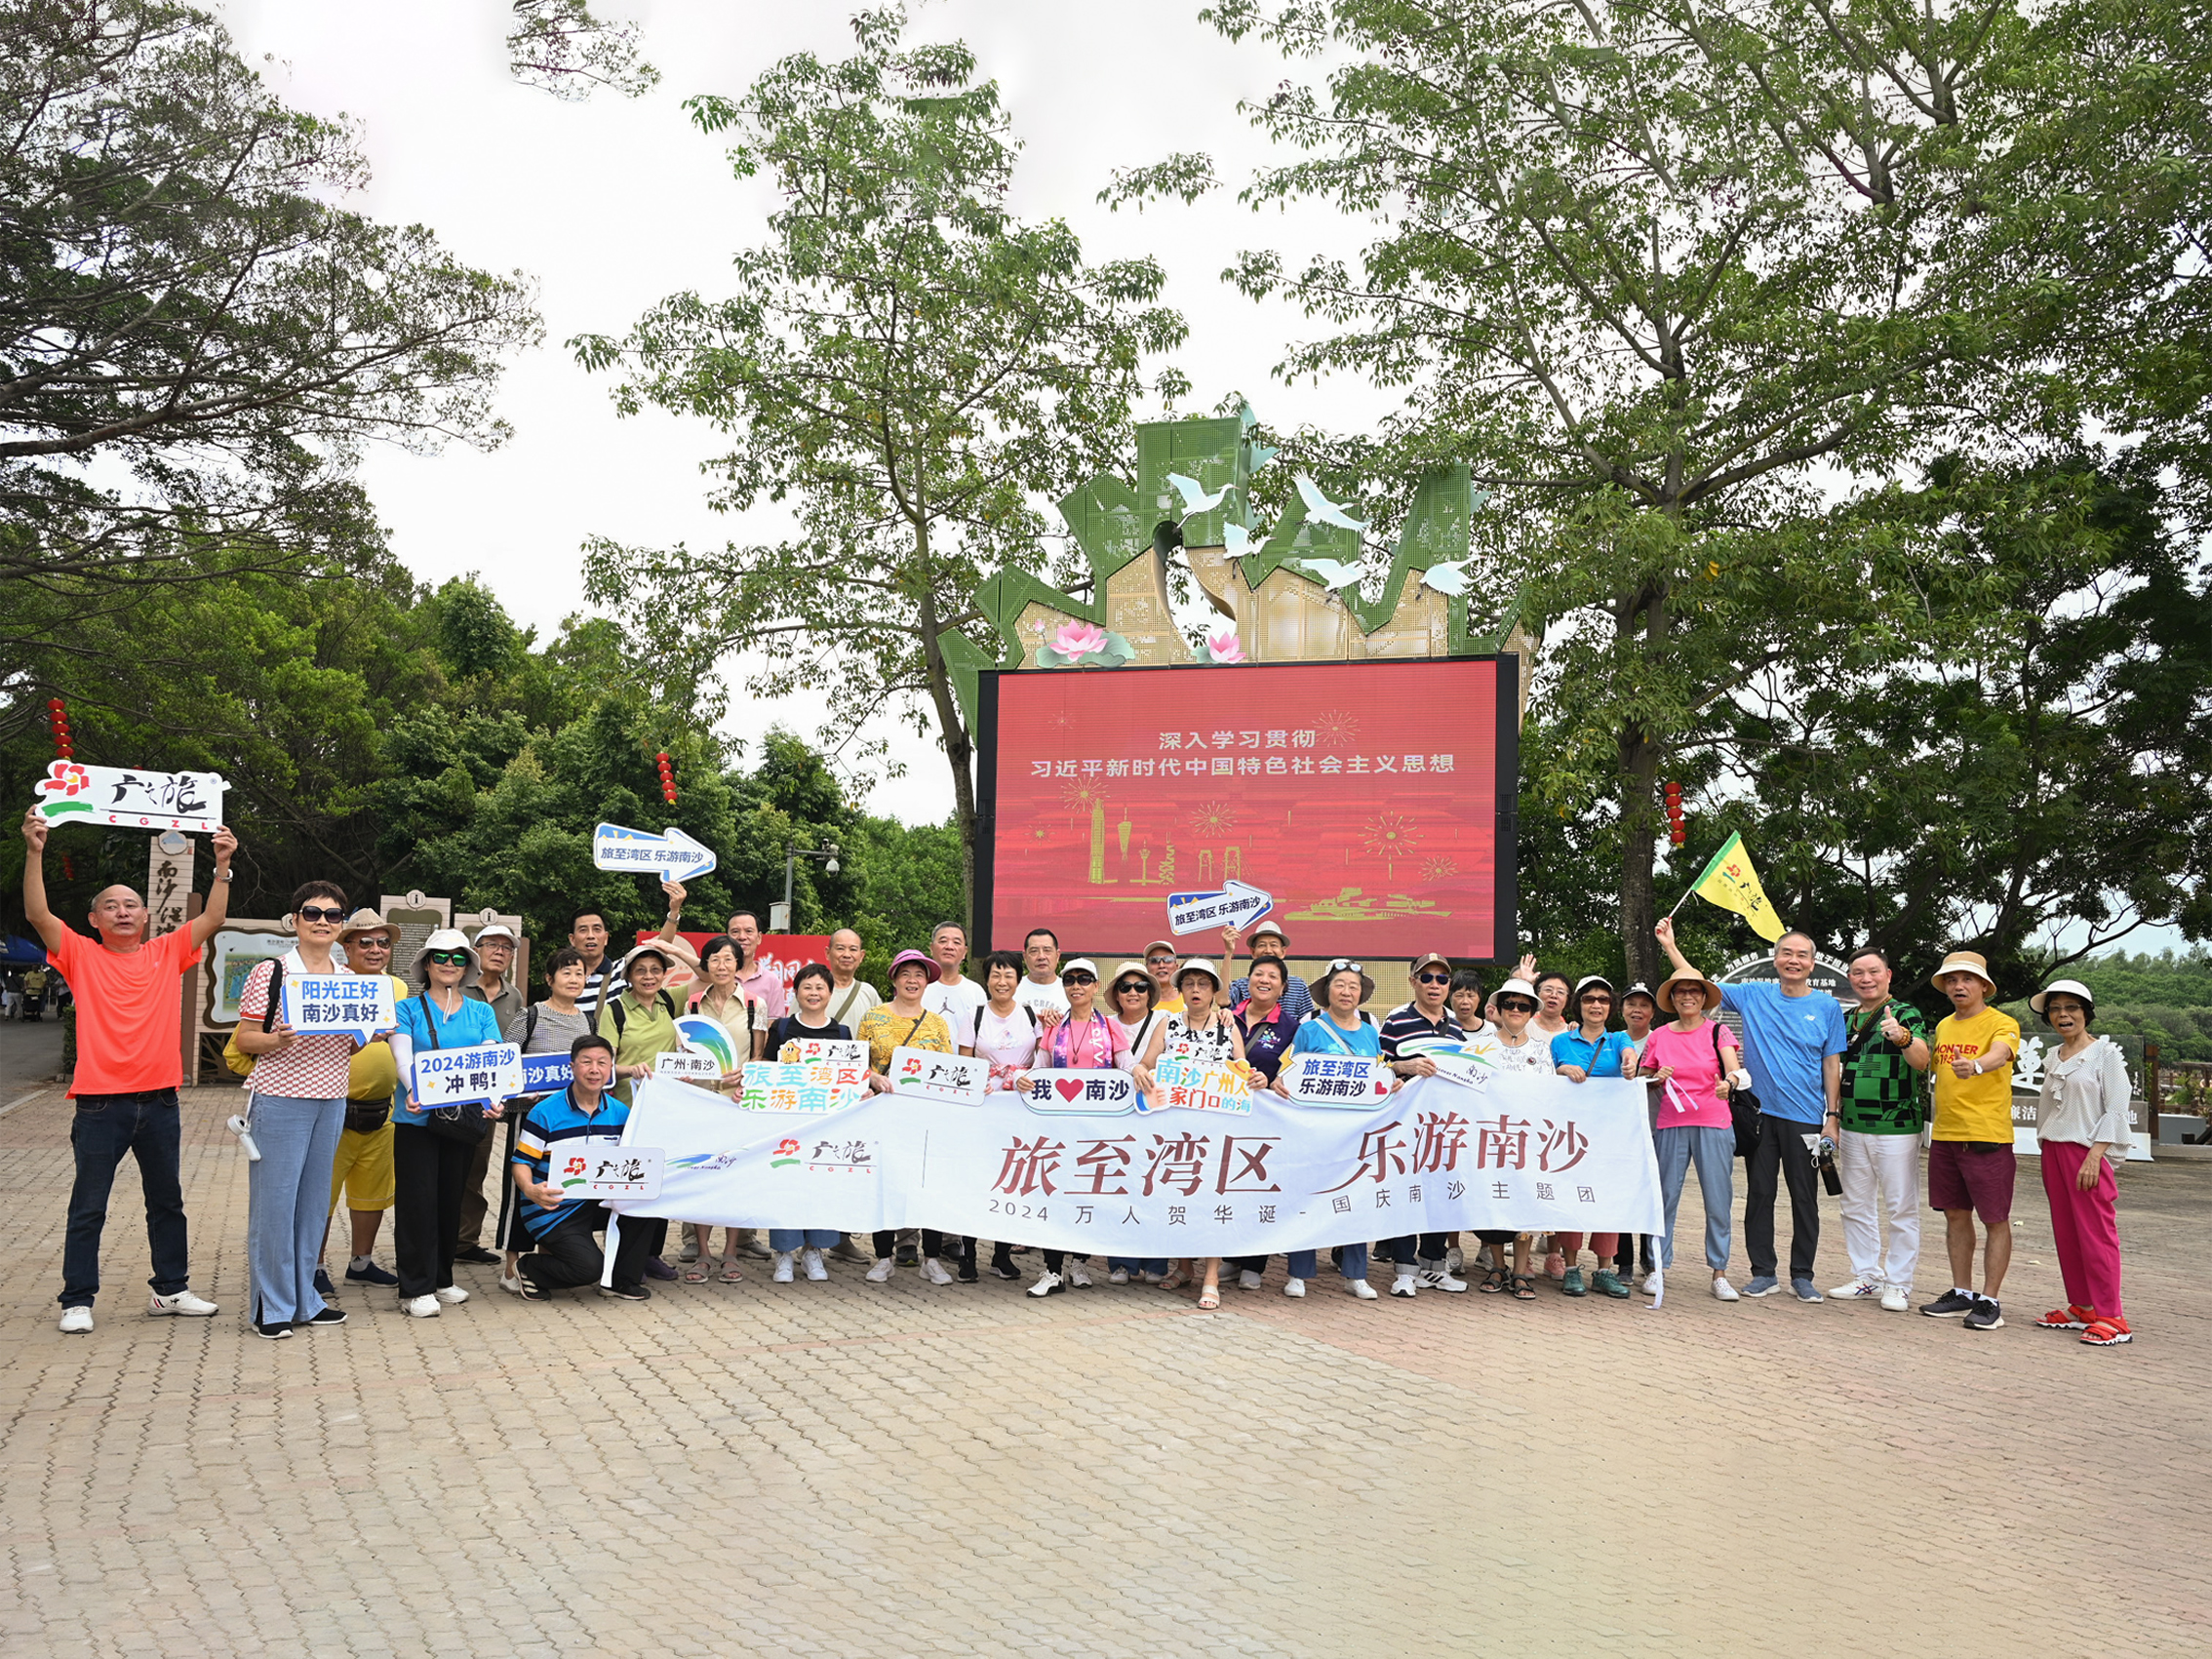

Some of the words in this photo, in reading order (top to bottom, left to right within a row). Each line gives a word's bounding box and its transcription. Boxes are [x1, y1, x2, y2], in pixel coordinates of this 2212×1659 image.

[1158, 729, 1317, 750] 深入学习贯彻
[1030, 753, 1455, 778] 习近平新时代中国特色社会主义思想
[111, 773, 208, 814] 广之旅
[600, 847, 652, 862] 旅至湾区
[653, 849, 704, 864] 乐游南沙
[1174, 905, 1217, 927] 旅至湾区
[1217, 895, 1261, 916] 乐游南沙
[301, 979, 379, 1001] 阳光正好
[301, 1003, 380, 1023] 南沙真好
[1934, 1042, 1979, 1055] MONLER
[420, 1048, 516, 1074] 2024游南沙
[660, 1057, 716, 1072] 广州·南沙
[1302, 1057, 1371, 1080] 旅至湾区
[742, 1063, 860, 1087] 旅至湾区
[928, 1064, 971, 1087] 广之旅
[1298, 1077, 1367, 1097] 乐游南沙
[741, 1086, 860, 1112] 乐游南沙
[1031, 1078, 1052, 1101] 我
[1086, 1078, 1130, 1102] 南沙
[1168, 1086, 1251, 1113] 家门口的海
[811, 1140, 873, 1165] 广之旅
[990, 1131, 1283, 1198] 旅至湾区
[1309, 1111, 1590, 1196] 乐游南沙
[595, 1158, 646, 1182] 广之旅
